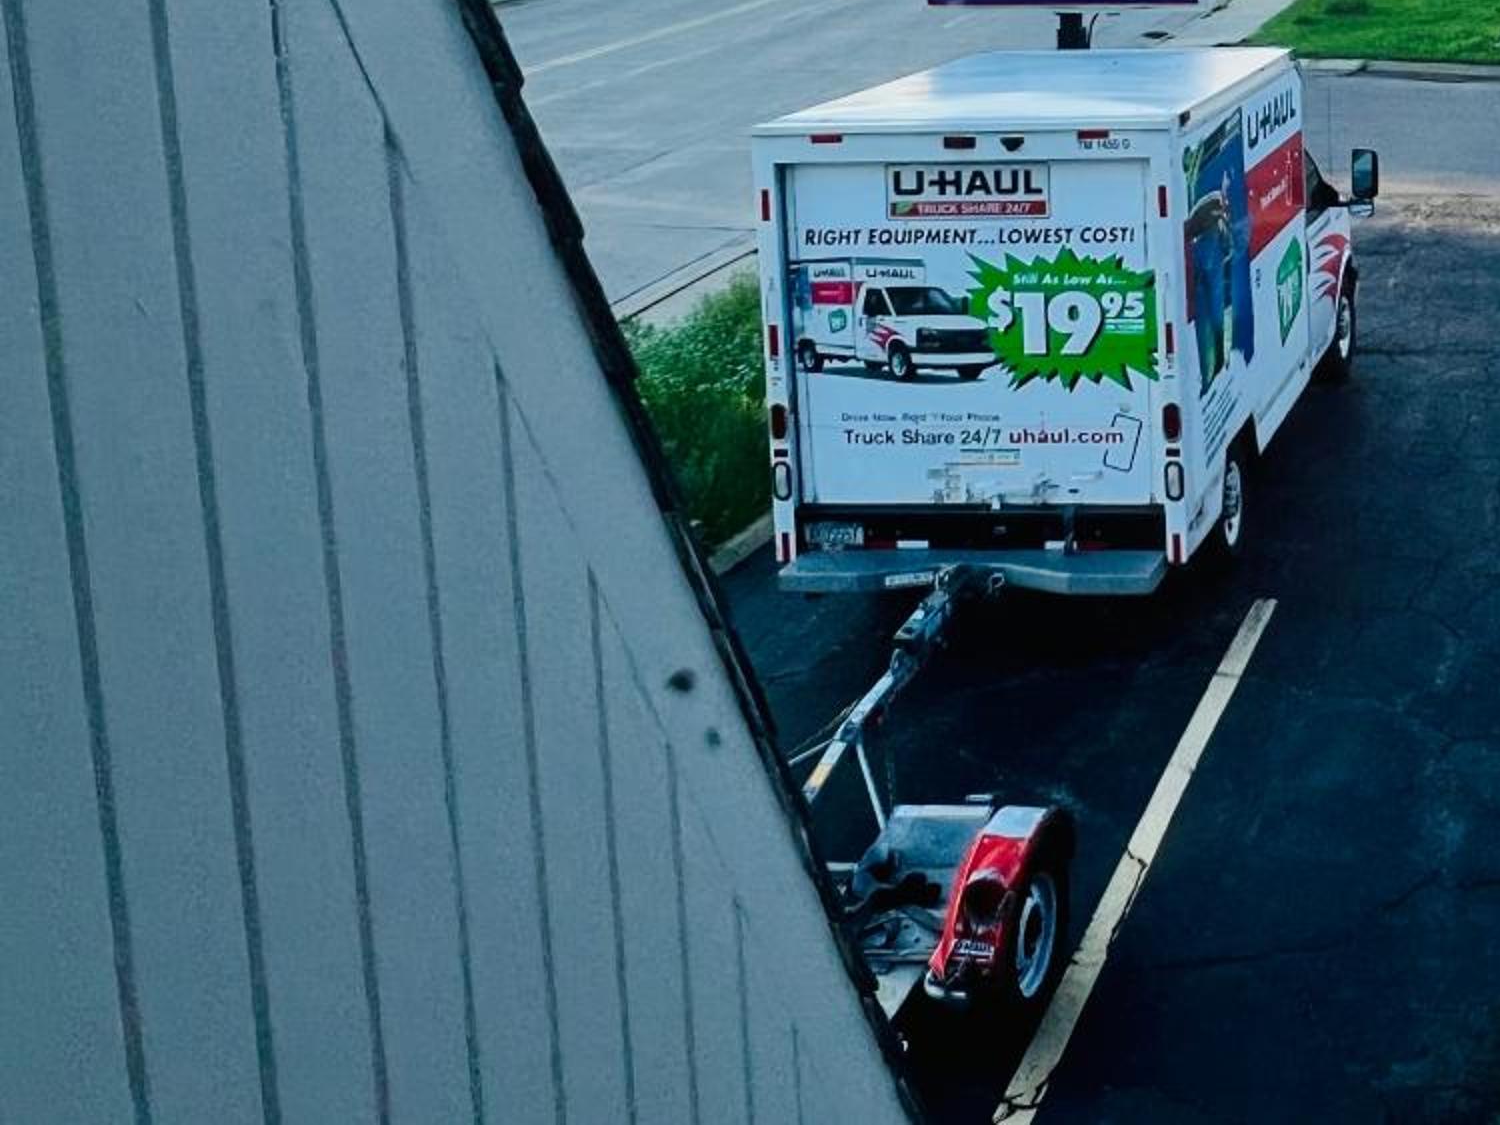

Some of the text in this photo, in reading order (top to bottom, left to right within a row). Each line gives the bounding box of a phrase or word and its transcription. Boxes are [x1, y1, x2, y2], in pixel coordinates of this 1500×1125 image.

[1247, 87, 1296, 149] U-HAUL
[893, 170, 1043, 195] U-HAUL
[917, 202, 1031, 214] TRUCK SHARE 24/7
[805, 228, 862, 245] RIGHT
[1080, 227, 1135, 243] COST!
[1063, 274, 1093, 285] Low
[843, 427, 1124, 446] Truck Share 24/7 uhaul.com
